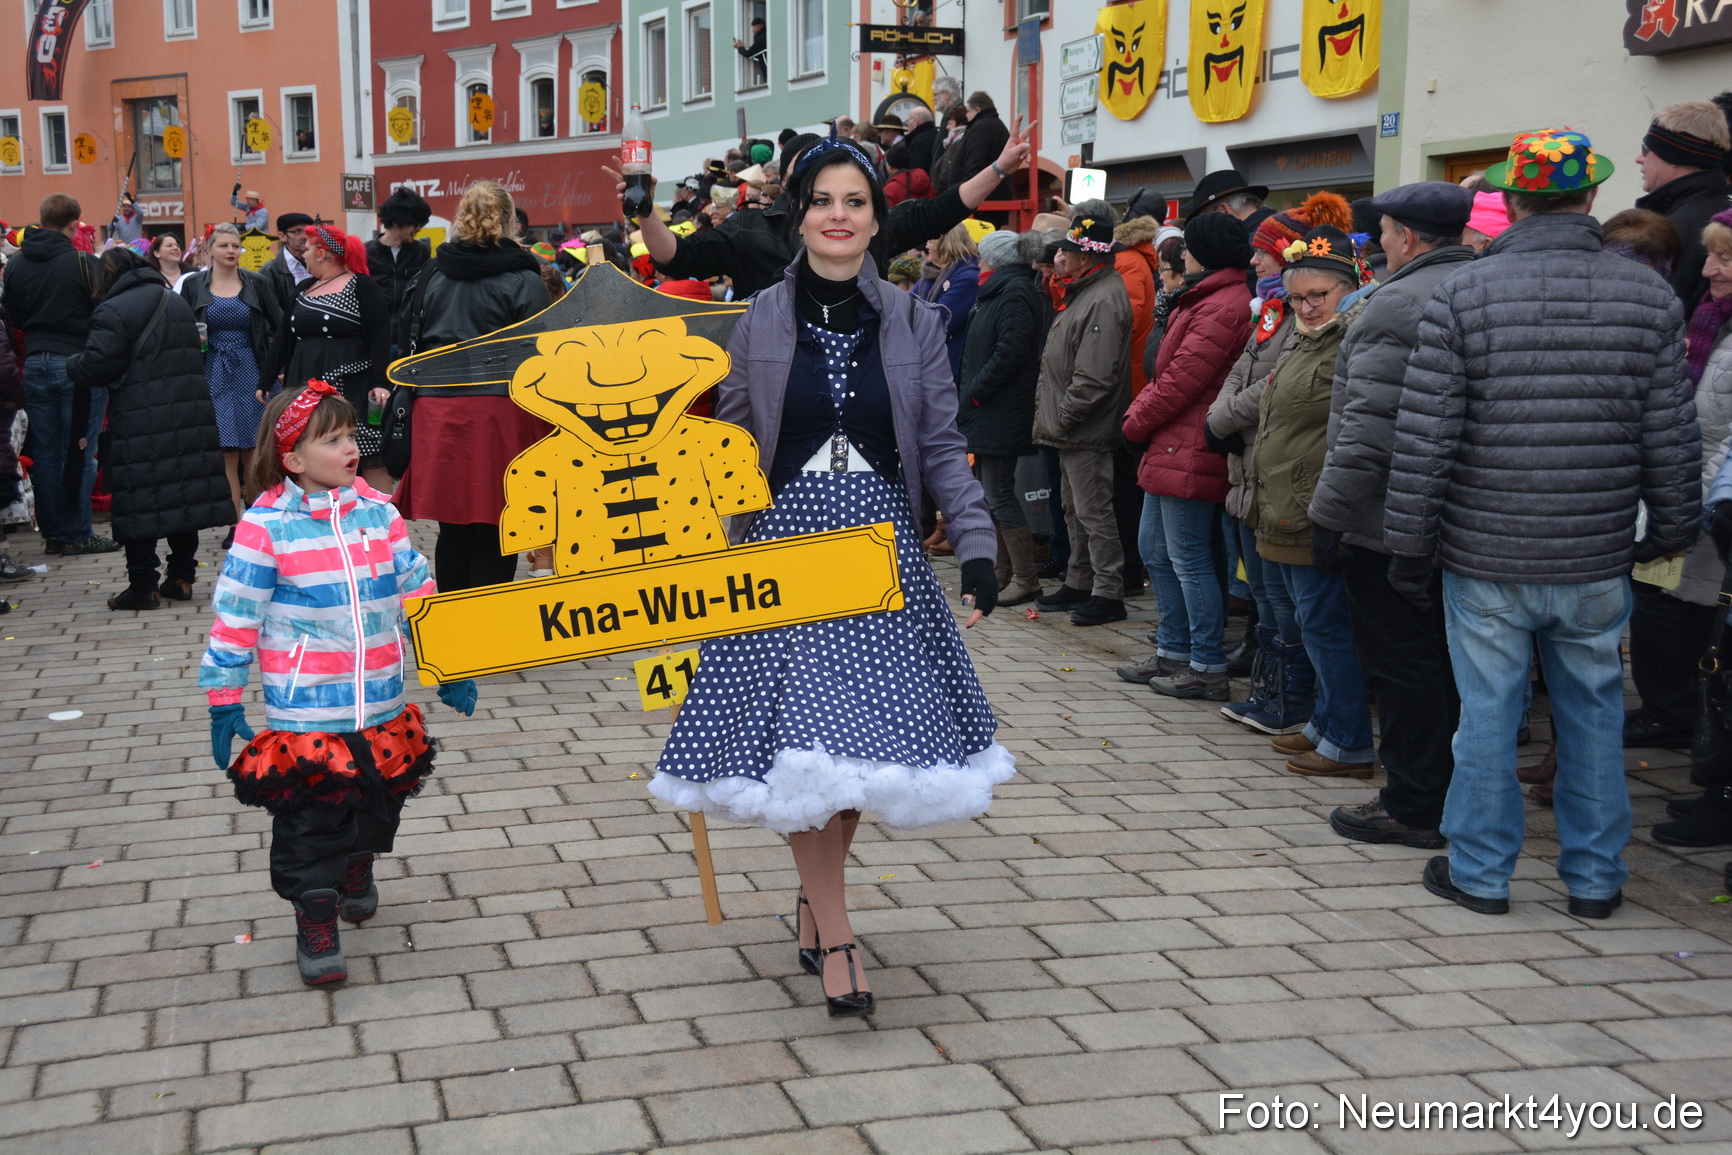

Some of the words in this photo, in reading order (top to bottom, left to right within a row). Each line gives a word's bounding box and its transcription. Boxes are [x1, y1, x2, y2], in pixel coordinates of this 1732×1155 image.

[870, 29, 954, 44] RÖHLICH
[1383, 114, 1396, 128] 20
[1294, 149, 1352, 170] UHREN
[345, 178, 371, 192] CAFÉ
[539, 573, 782, 642] Kna-Wu-Ha
[646, 657, 693, 700] 41
